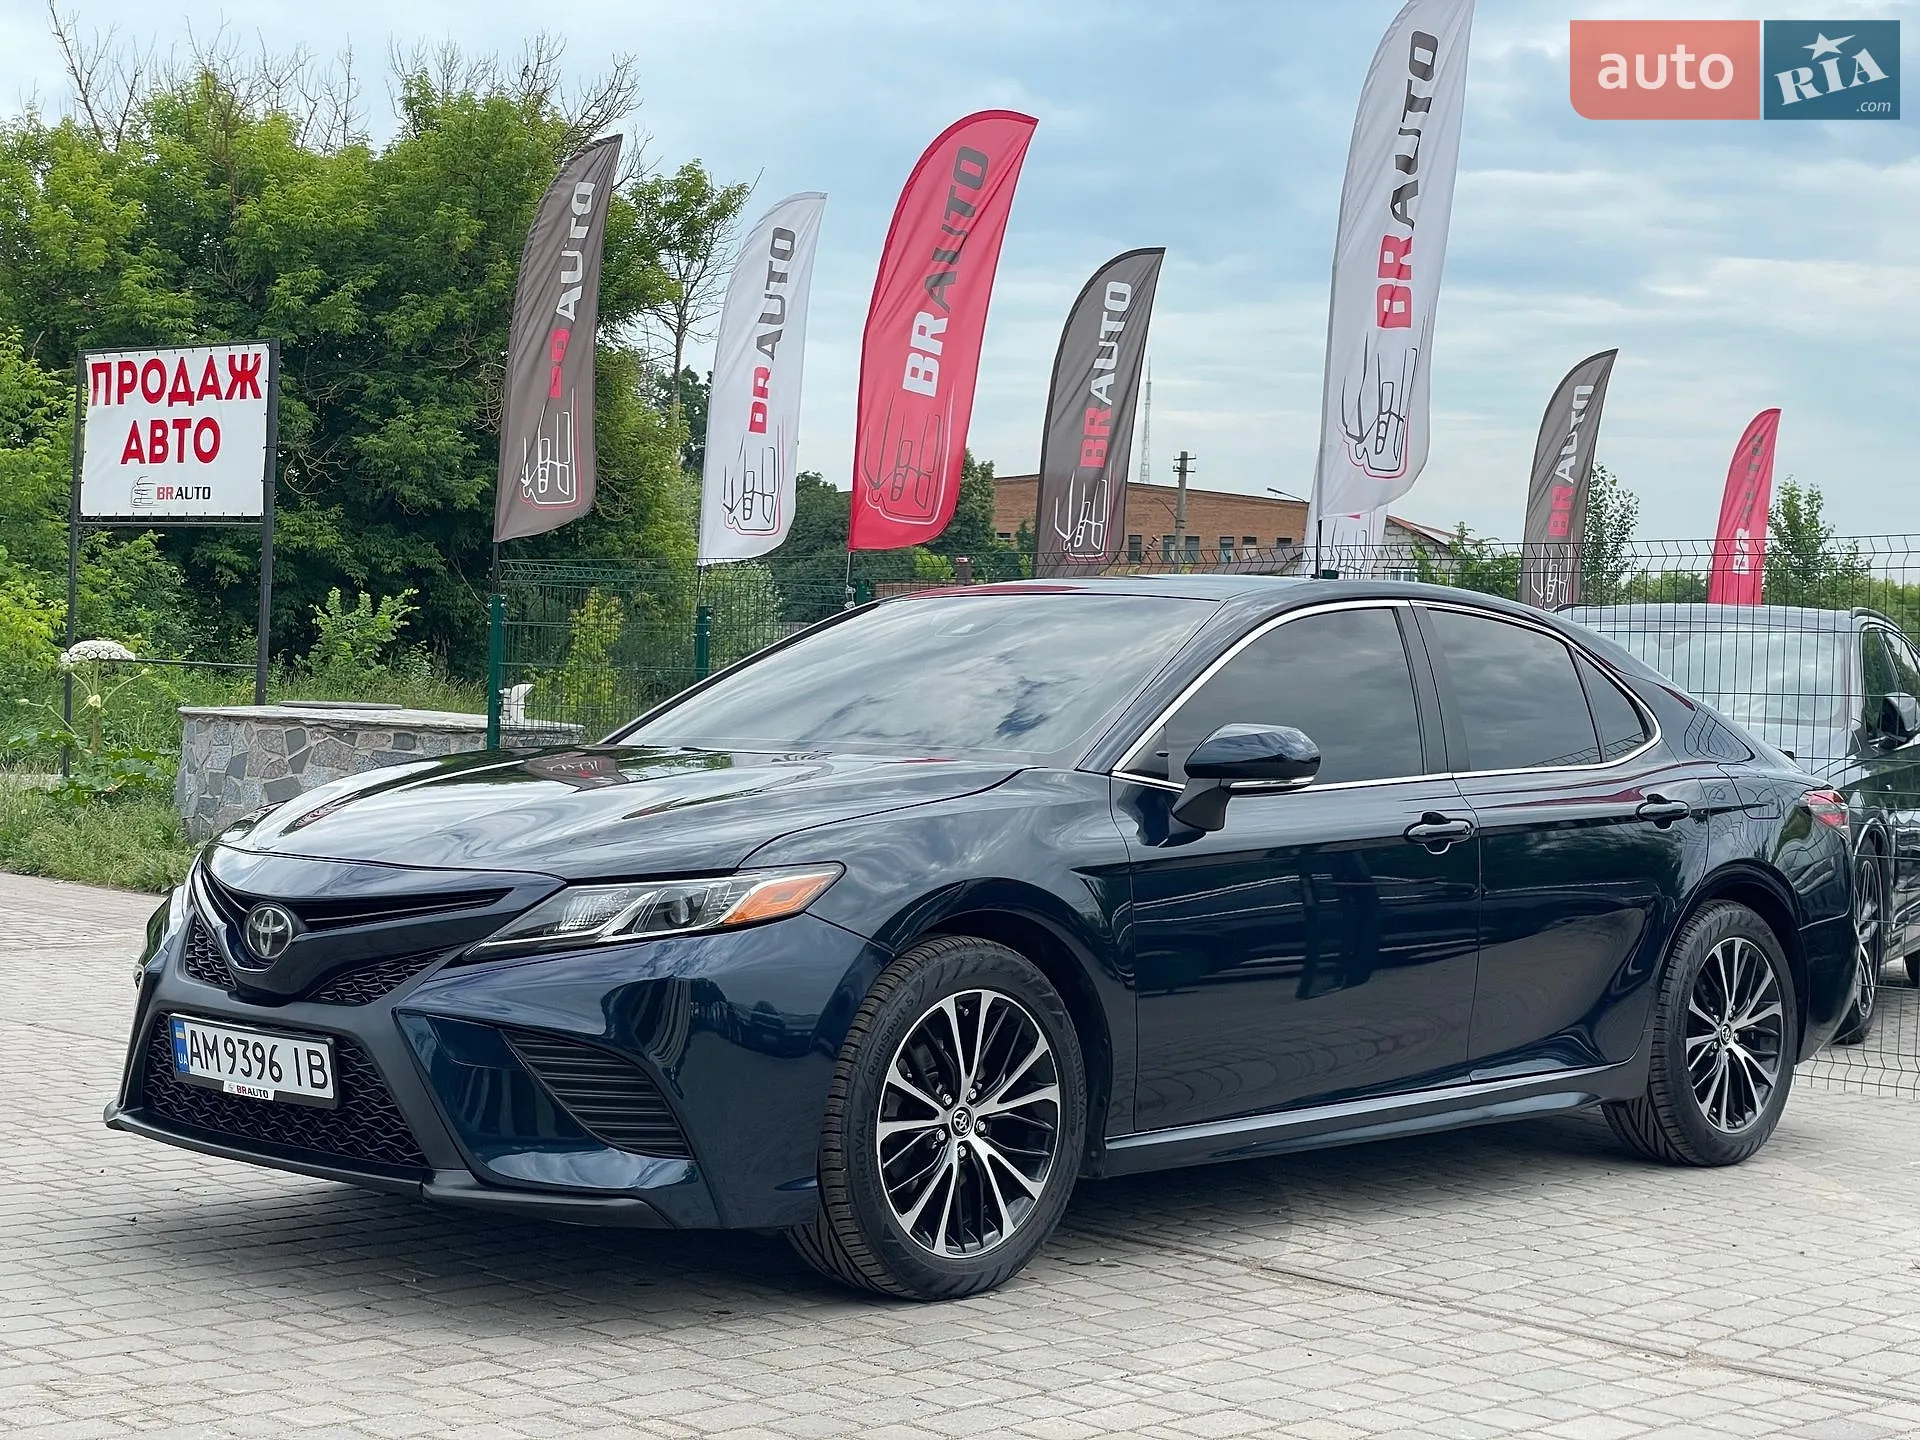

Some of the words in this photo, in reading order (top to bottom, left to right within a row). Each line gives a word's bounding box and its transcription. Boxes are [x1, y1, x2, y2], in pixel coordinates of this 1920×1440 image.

[1376, 30, 1439, 329] BRAUTO
[902, 145, 991, 398] BRAUTO
[91, 353, 262, 407] ПРОДАЖ
[1079, 281, 1132, 469] BRAUTO
[120, 416, 221, 464] АВТО
[156, 486, 211, 500] BRAUTO
[178, 1053, 188, 1066] UA
[236, 1085, 269, 1099] BRAUTO
